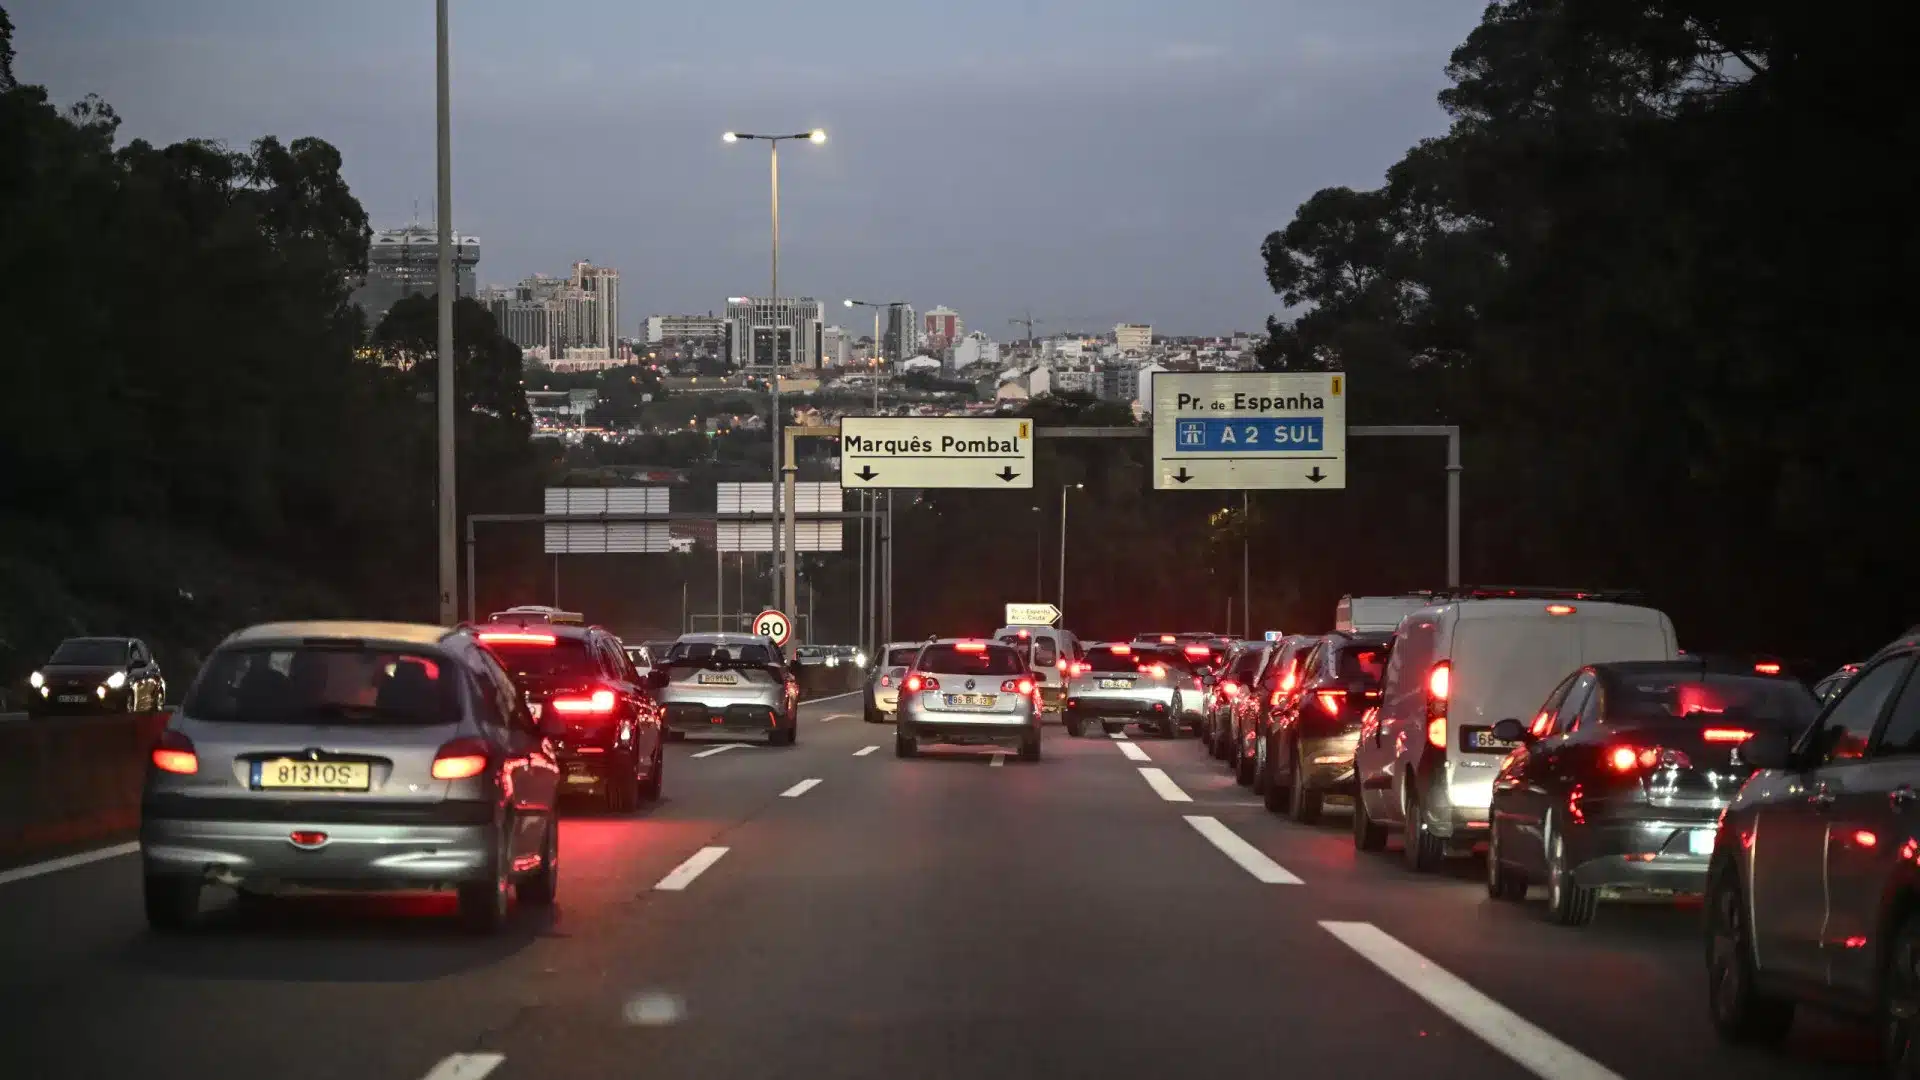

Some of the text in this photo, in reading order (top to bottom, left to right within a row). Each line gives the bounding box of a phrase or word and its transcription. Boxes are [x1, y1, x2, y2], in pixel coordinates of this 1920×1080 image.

[1178, 393, 1325, 412] Pr. de Espanha
[1221, 425, 1320, 444] A 2 SUL
[845, 436, 1020, 455] Marquês Pombal
[760, 622, 784, 636] 80
